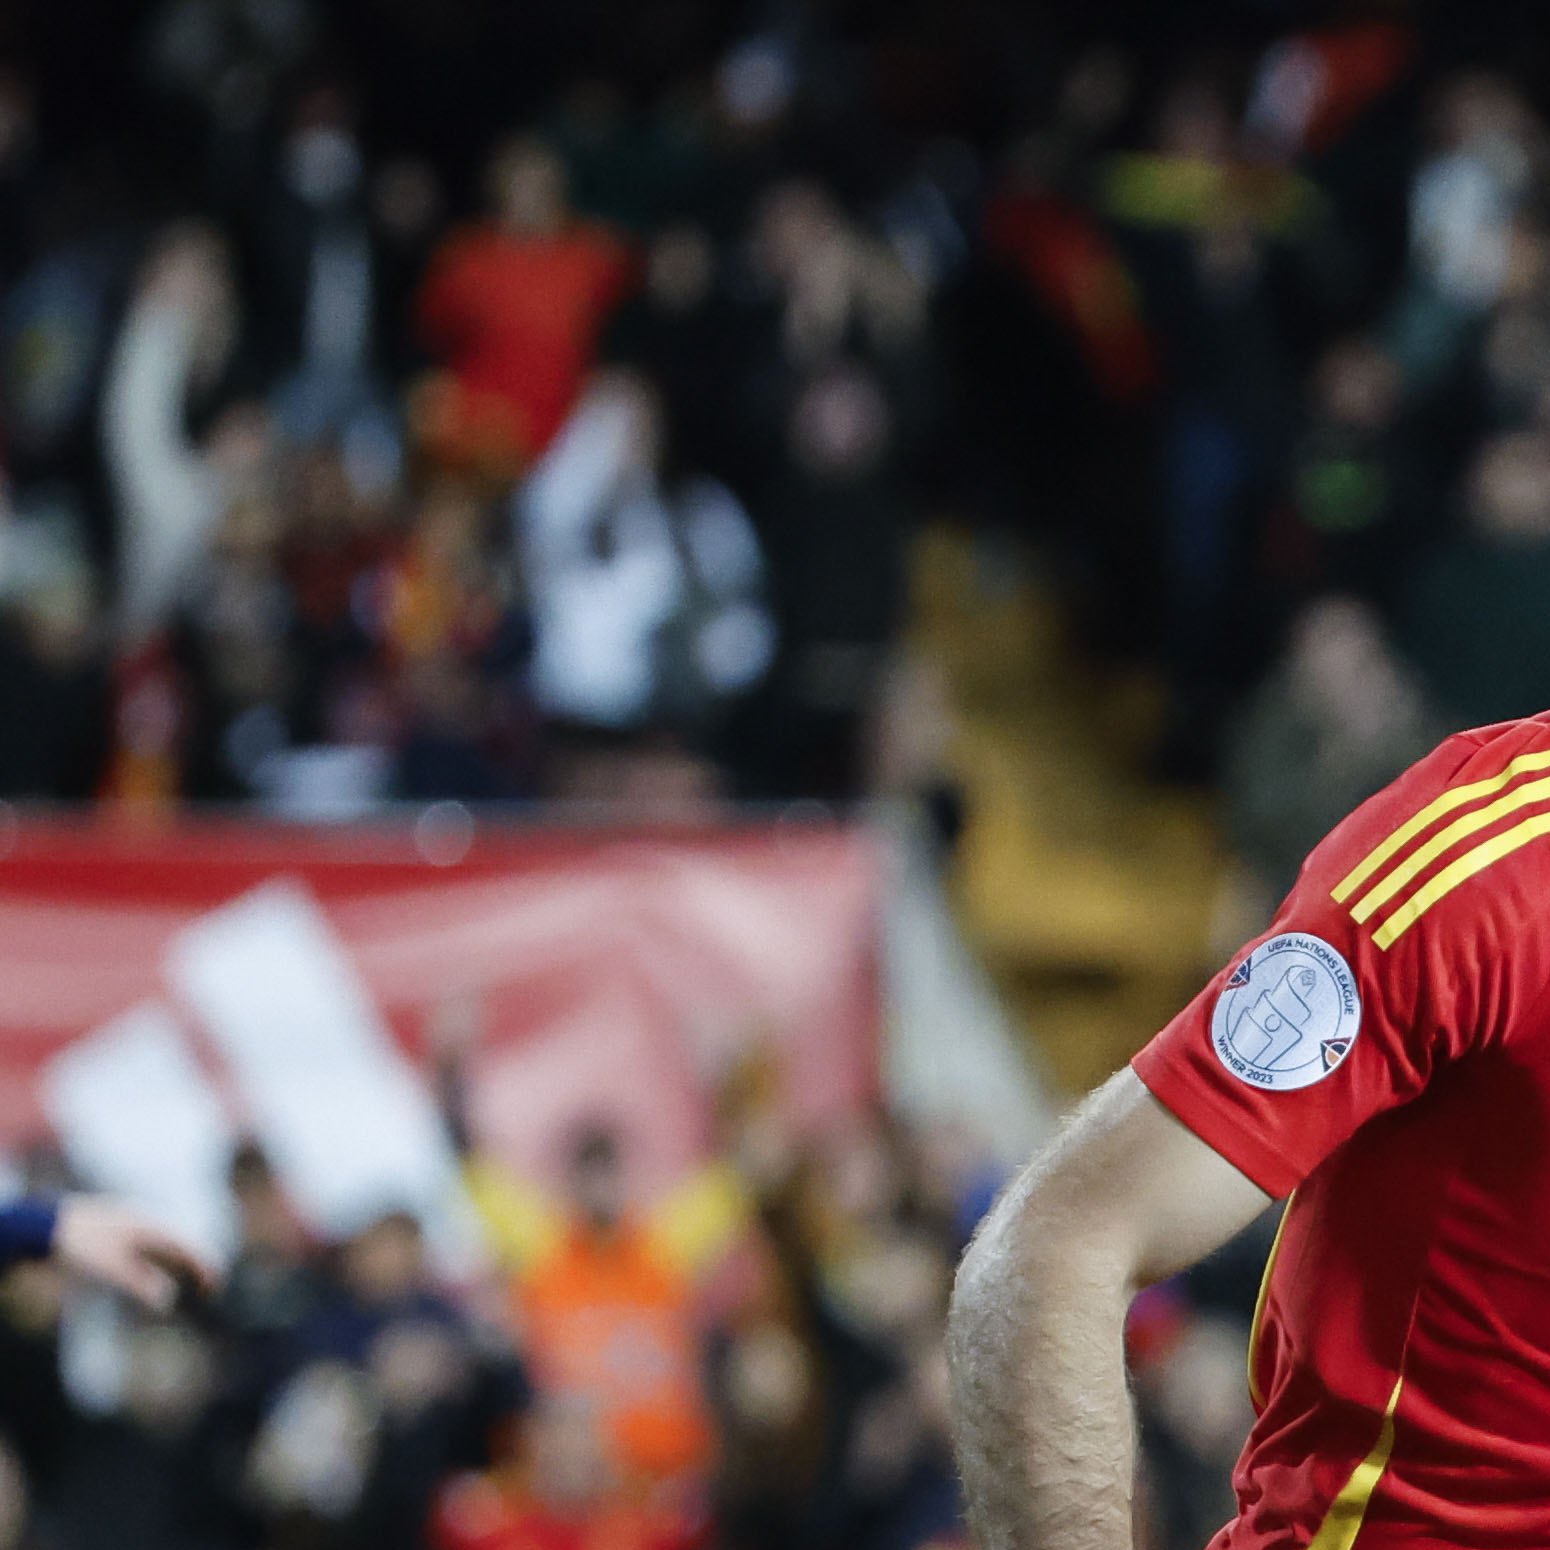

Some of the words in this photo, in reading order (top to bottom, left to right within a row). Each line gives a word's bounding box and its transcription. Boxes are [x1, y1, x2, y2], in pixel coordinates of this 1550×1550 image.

[1267, 939, 1292, 952] UEFA
[1295, 938, 1338, 969] NATIONS
[1334, 969, 1354, 1015] LEAGUE
[1218, 1035, 1246, 1073] WINNER
[1245, 1068, 1274, 1084] 2023
